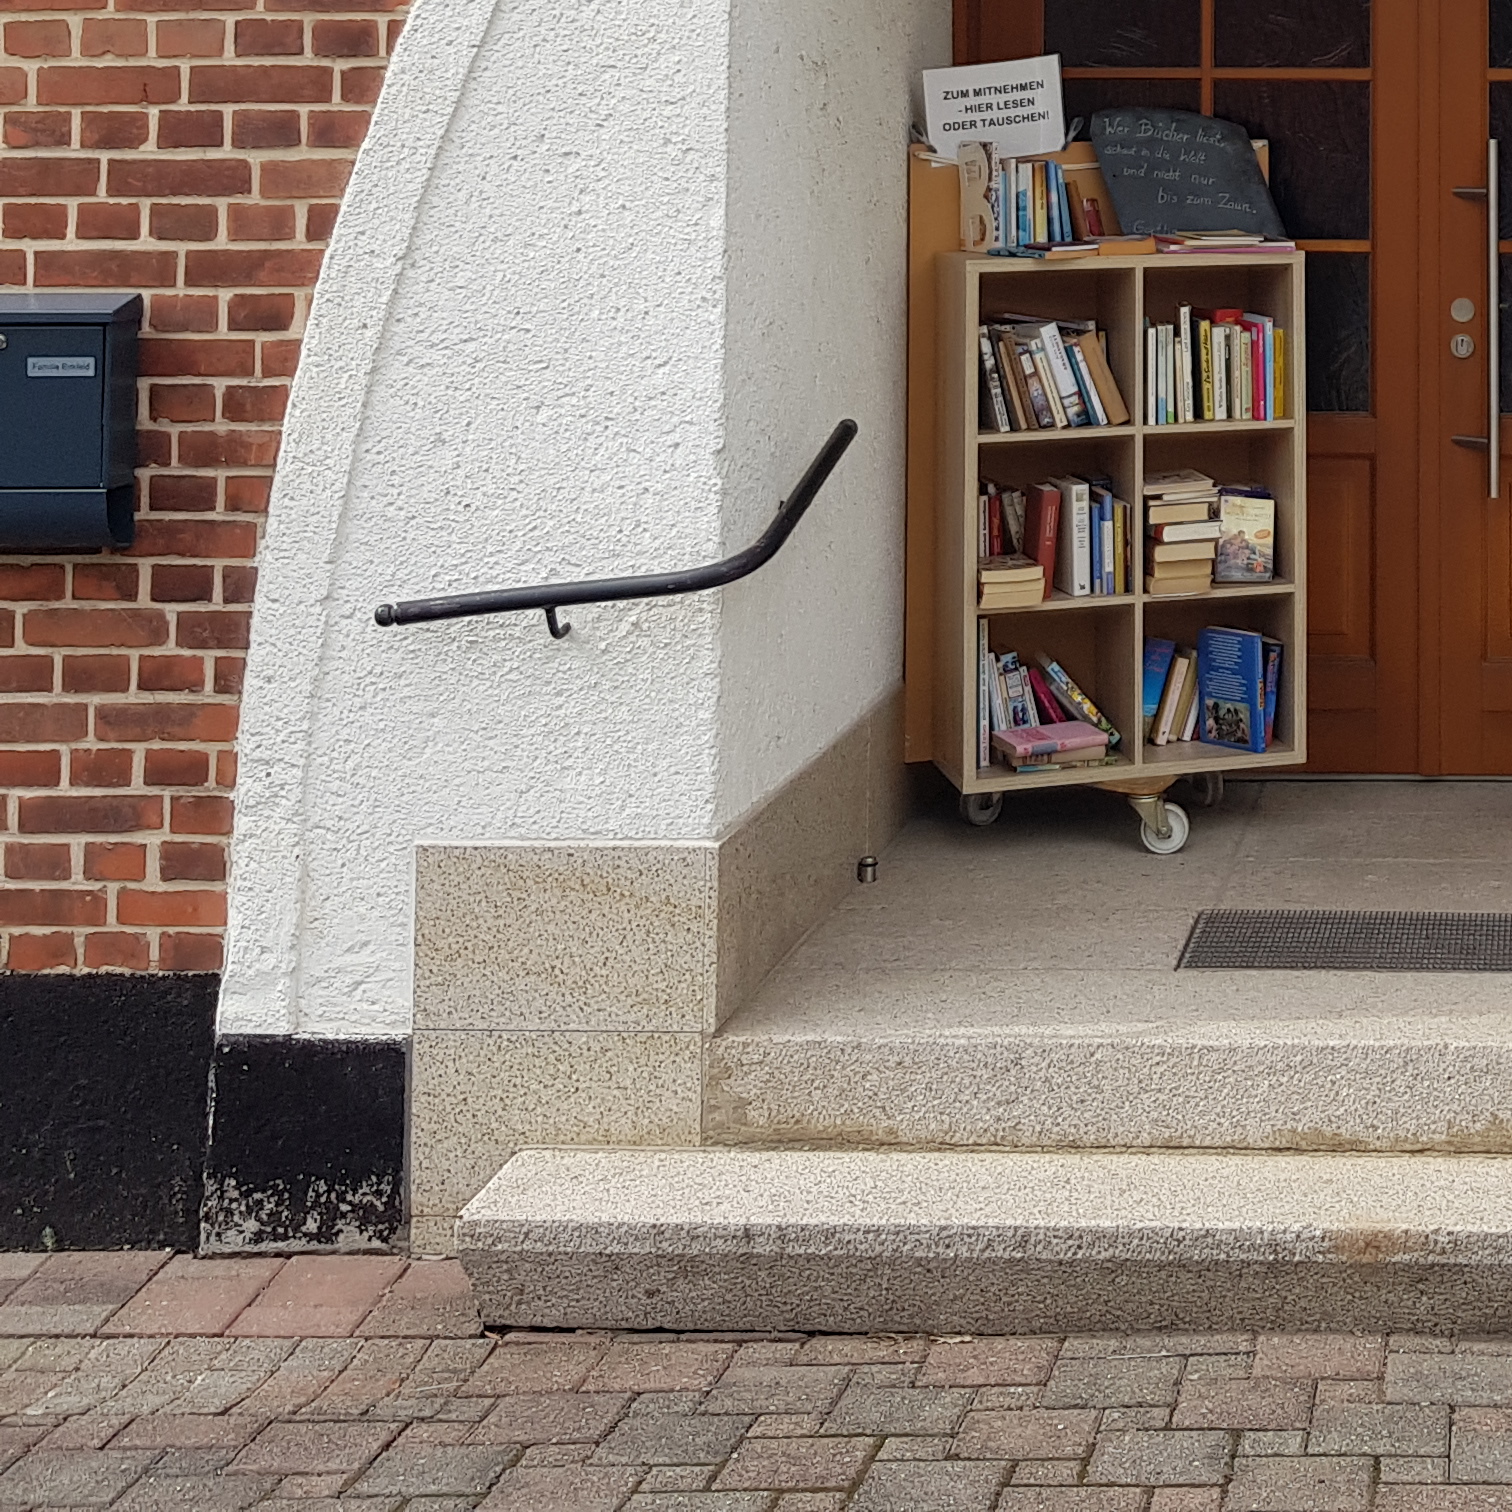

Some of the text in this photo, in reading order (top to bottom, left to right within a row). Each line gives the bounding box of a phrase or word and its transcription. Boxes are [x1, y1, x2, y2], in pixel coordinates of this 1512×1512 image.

[943, 79, 1045, 101] ZUM MITNEHMEN
[997, 96, 1035, 111] LESEN
[942, 110, 1050, 132] ODER TAUSCHEN!
[1104, 117, 1130, 135] Wer
[1136, 118, 1191, 143] Bücher
[1155, 145, 1171, 161] die
[1123, 163, 1216, 185] und nicht nur
[1157, 187, 1257, 214] bis zum Zaun.
